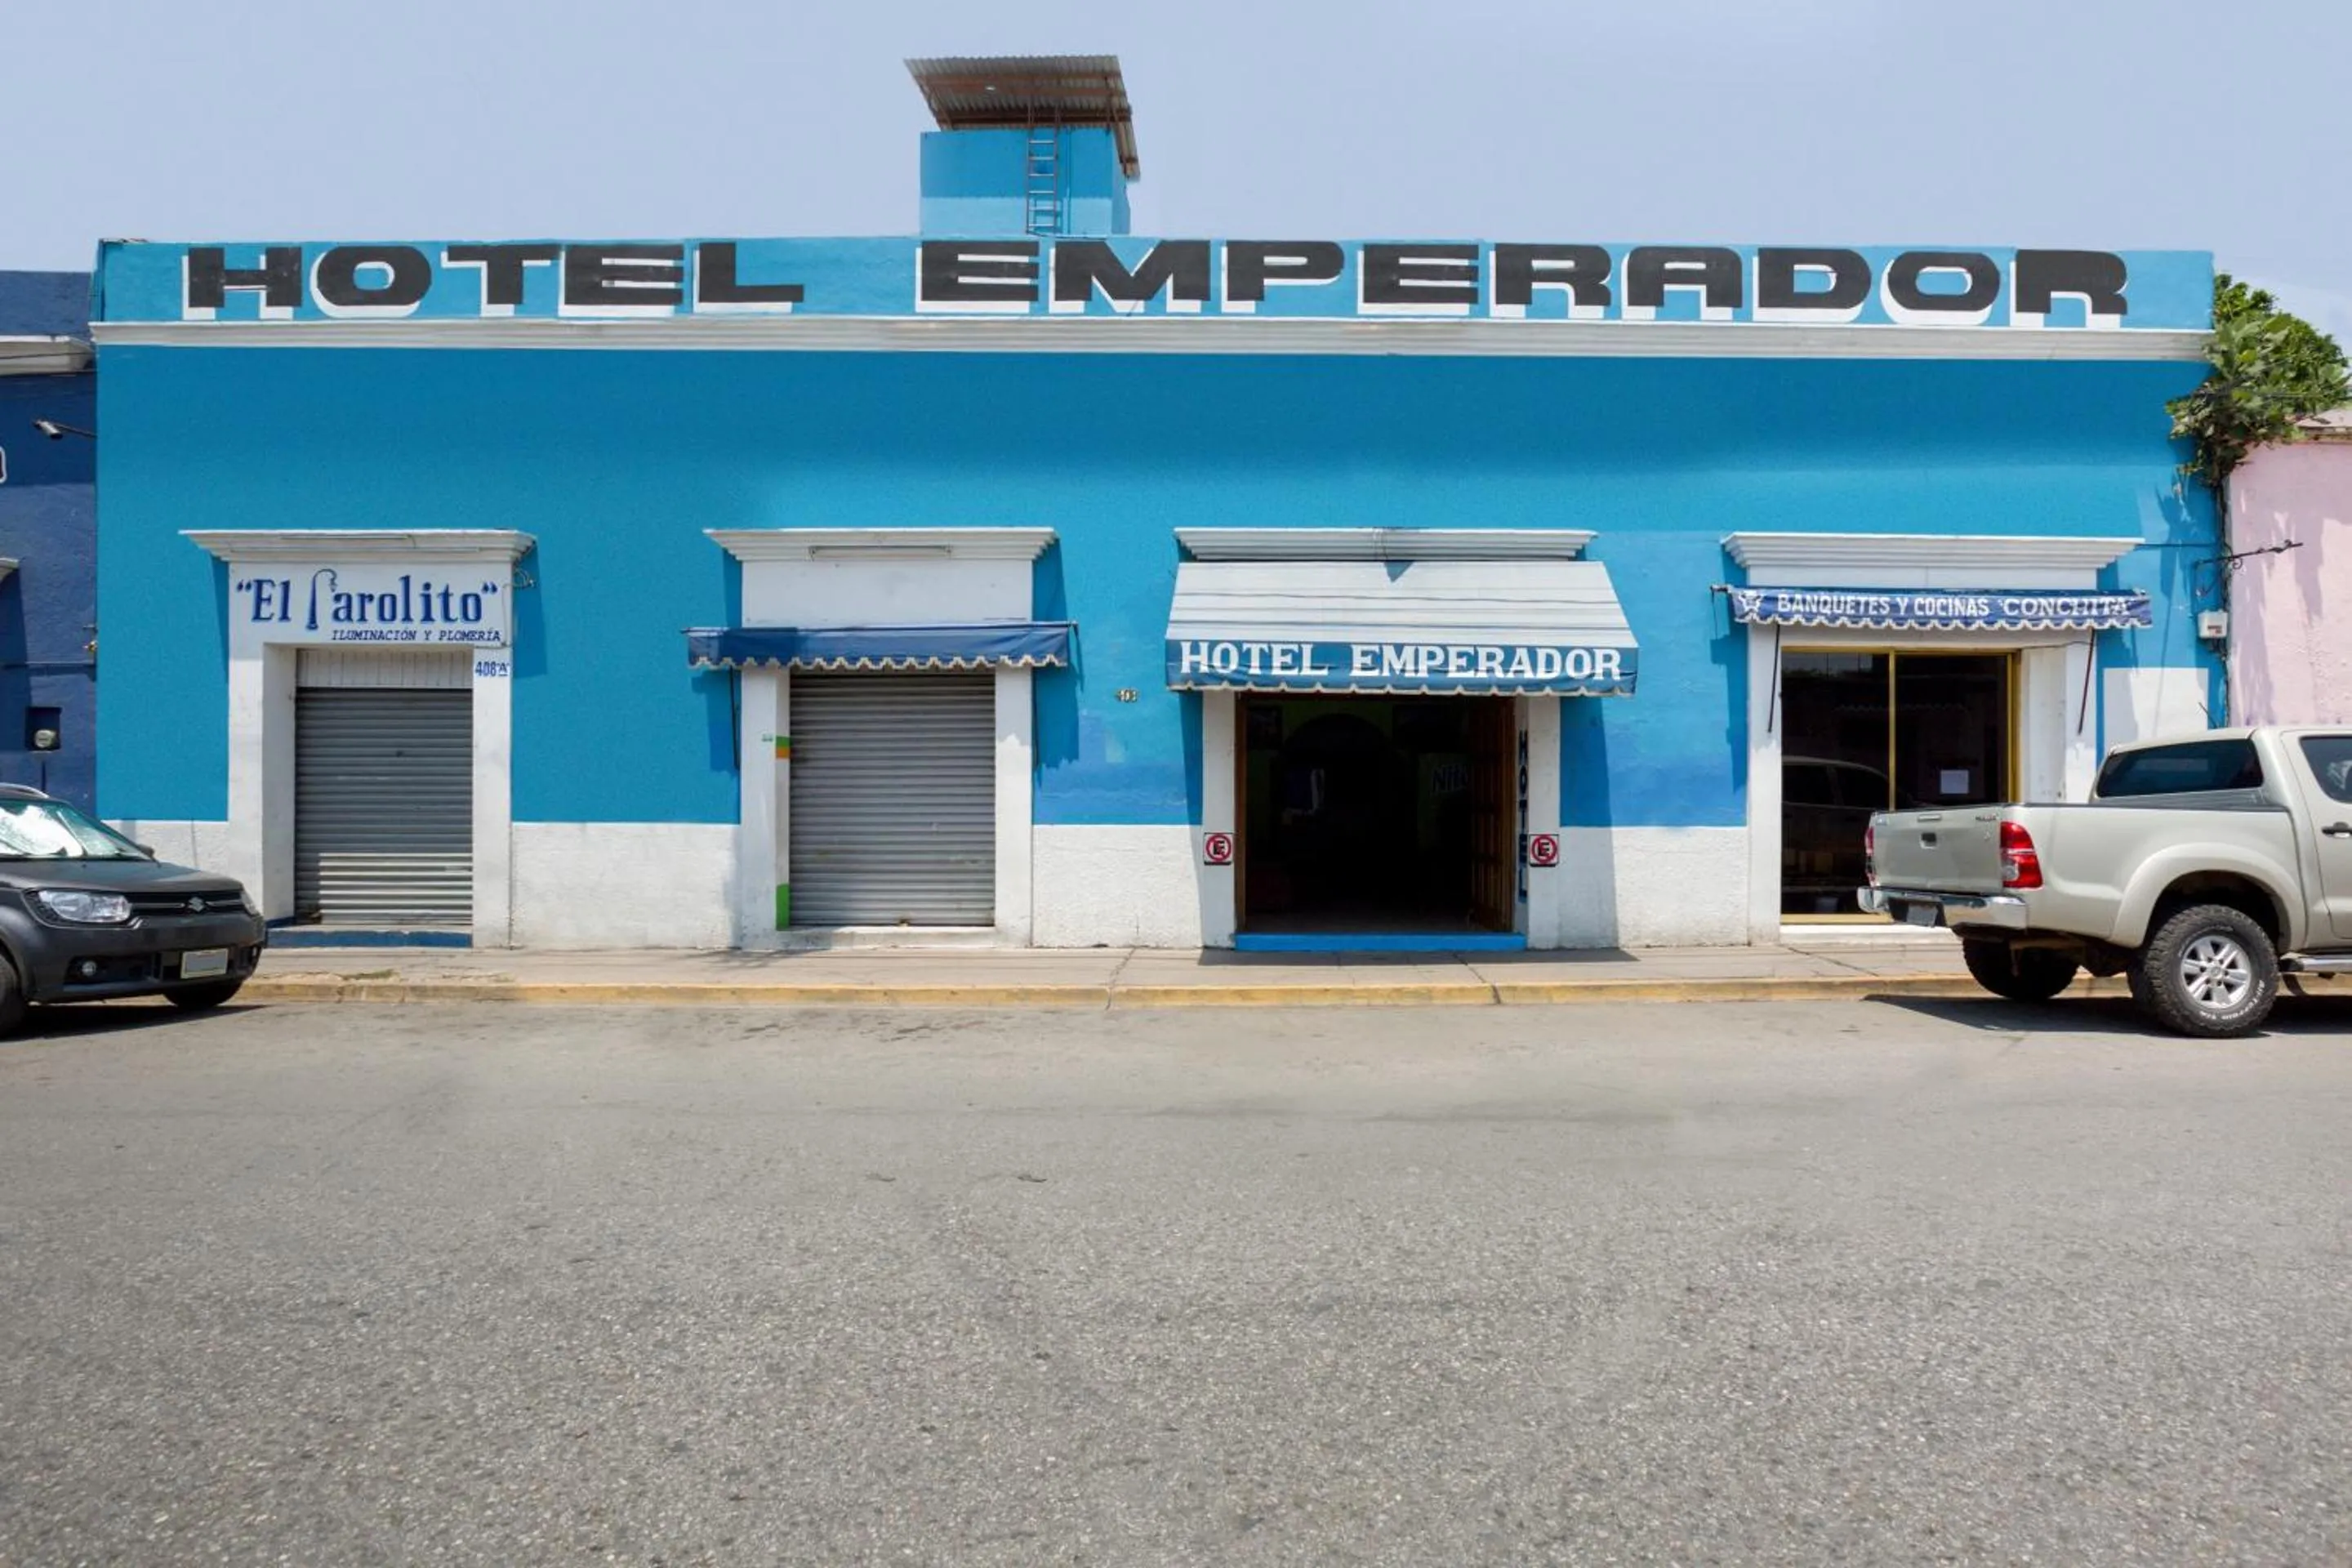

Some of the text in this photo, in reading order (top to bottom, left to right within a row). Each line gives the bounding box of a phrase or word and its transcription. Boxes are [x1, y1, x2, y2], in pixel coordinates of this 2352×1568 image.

[181, 240, 2128, 328] HOTEL EMPERADOR
[1777, 593, 1891, 615] BANQUETES
[1895, 597, 1909, 616] Y
[1913, 597, 1990, 617] COCINAS
[424, 630, 433, 641] Y
[1180, 641, 1622, 681] HOTEL EMPERADOR
[1517, 729, 1529, 903] HOTEL
